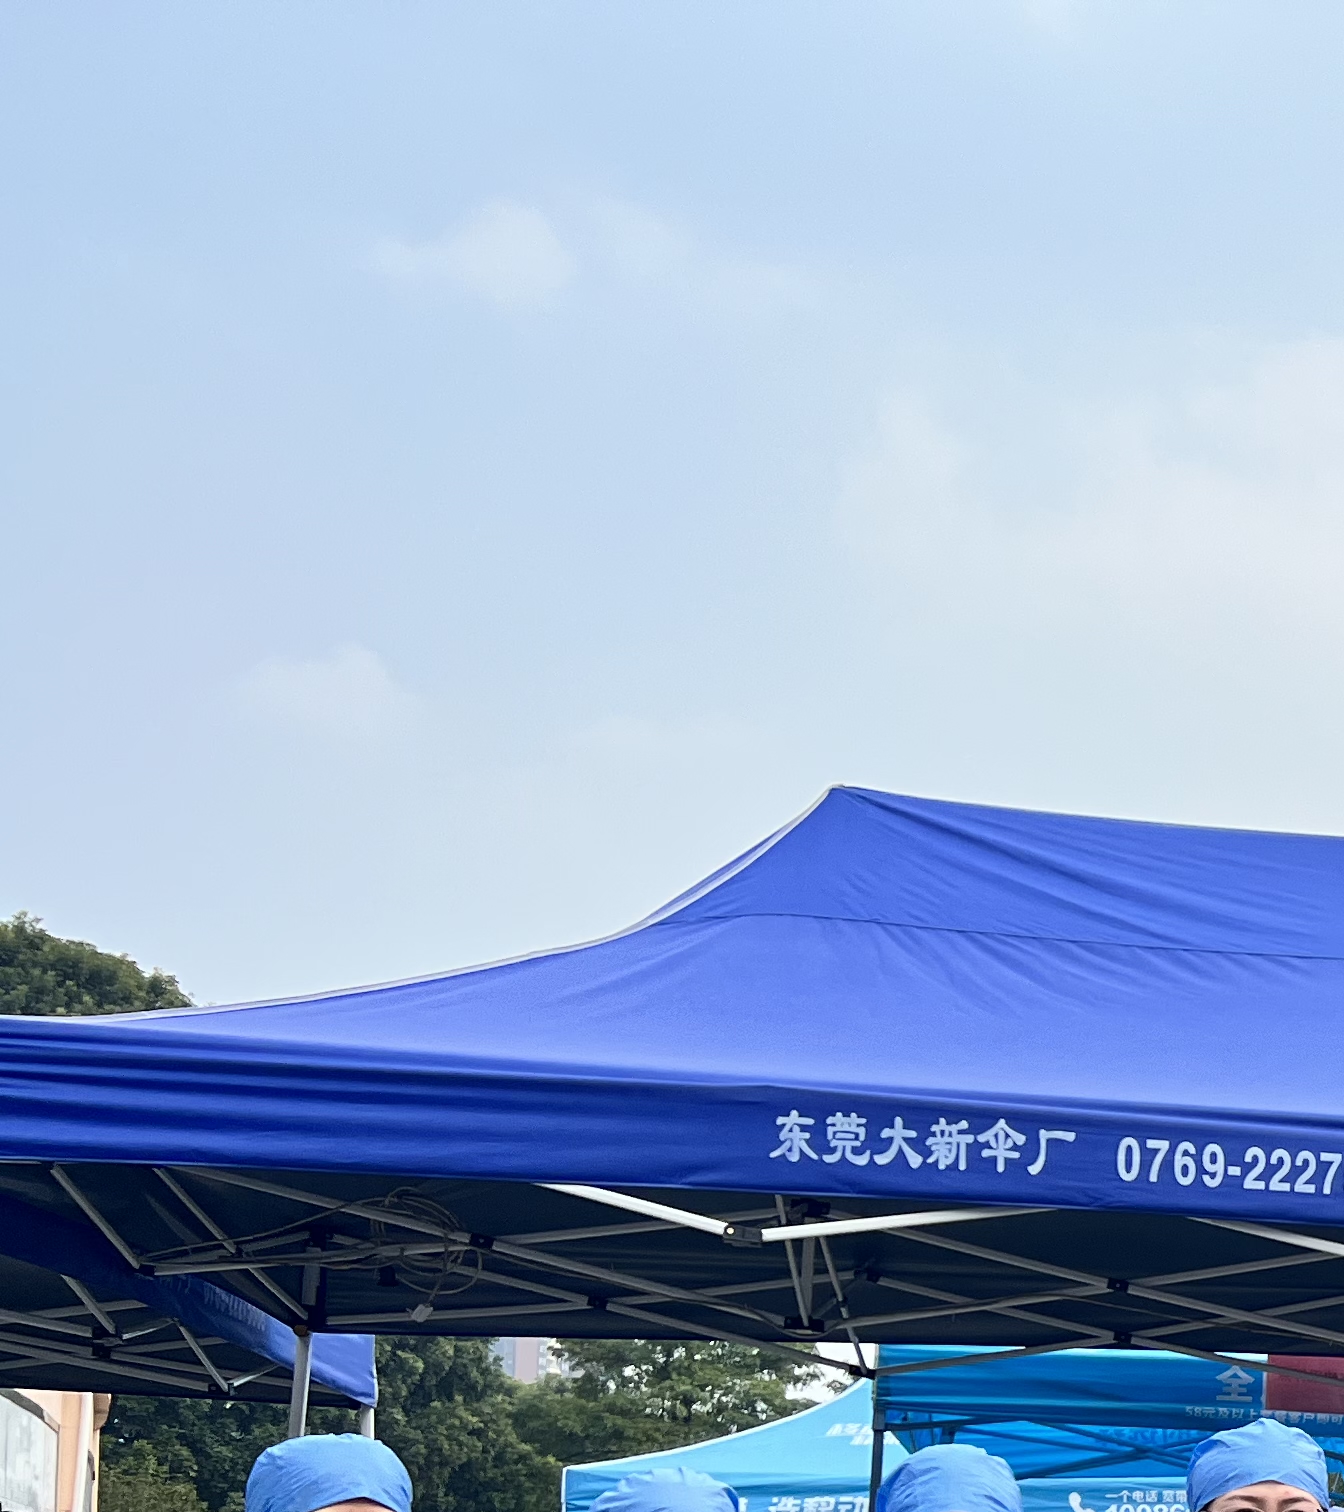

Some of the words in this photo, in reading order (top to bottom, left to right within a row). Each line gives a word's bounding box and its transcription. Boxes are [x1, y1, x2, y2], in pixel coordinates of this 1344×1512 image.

[768, 1109, 1076, 1176] 东莞大新伞厂
[1105, 1490, 1158, 1503] 一个电话
